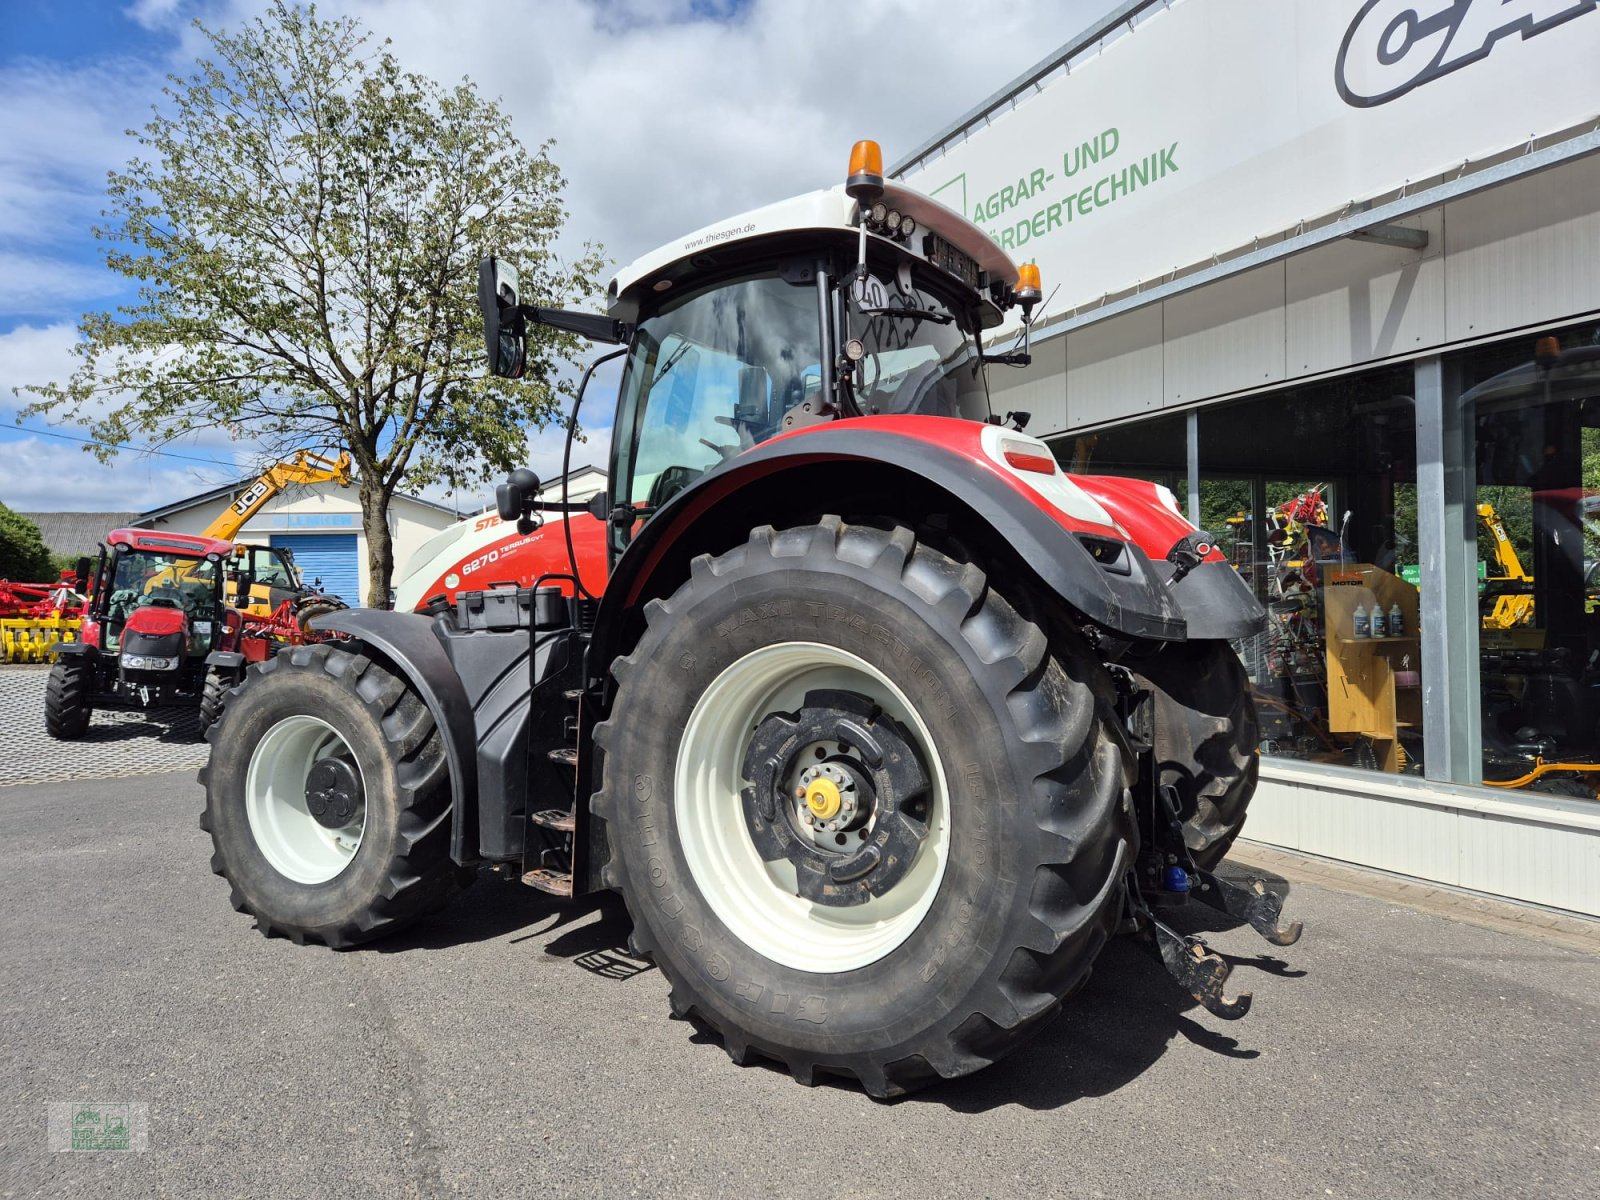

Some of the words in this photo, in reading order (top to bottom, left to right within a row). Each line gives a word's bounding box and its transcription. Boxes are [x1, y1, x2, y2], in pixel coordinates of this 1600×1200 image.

[973, 167, 1055, 224] AGRAR-
[1063, 127, 1120, 177] UND
[989, 141, 1179, 250] ÖRDERTECHNIK
[684, 223, 756, 250] www.thiesgen.de
[862, 282, 883, 308] 40
[236, 482, 268, 515] JCB
[474, 515, 505, 533] STE
[462, 550, 499, 576] 6270
[715, 599, 792, 639] MAXI
[804, 600, 961, 721] TRACTION
[633, 772, 829, 1025] Firestone
